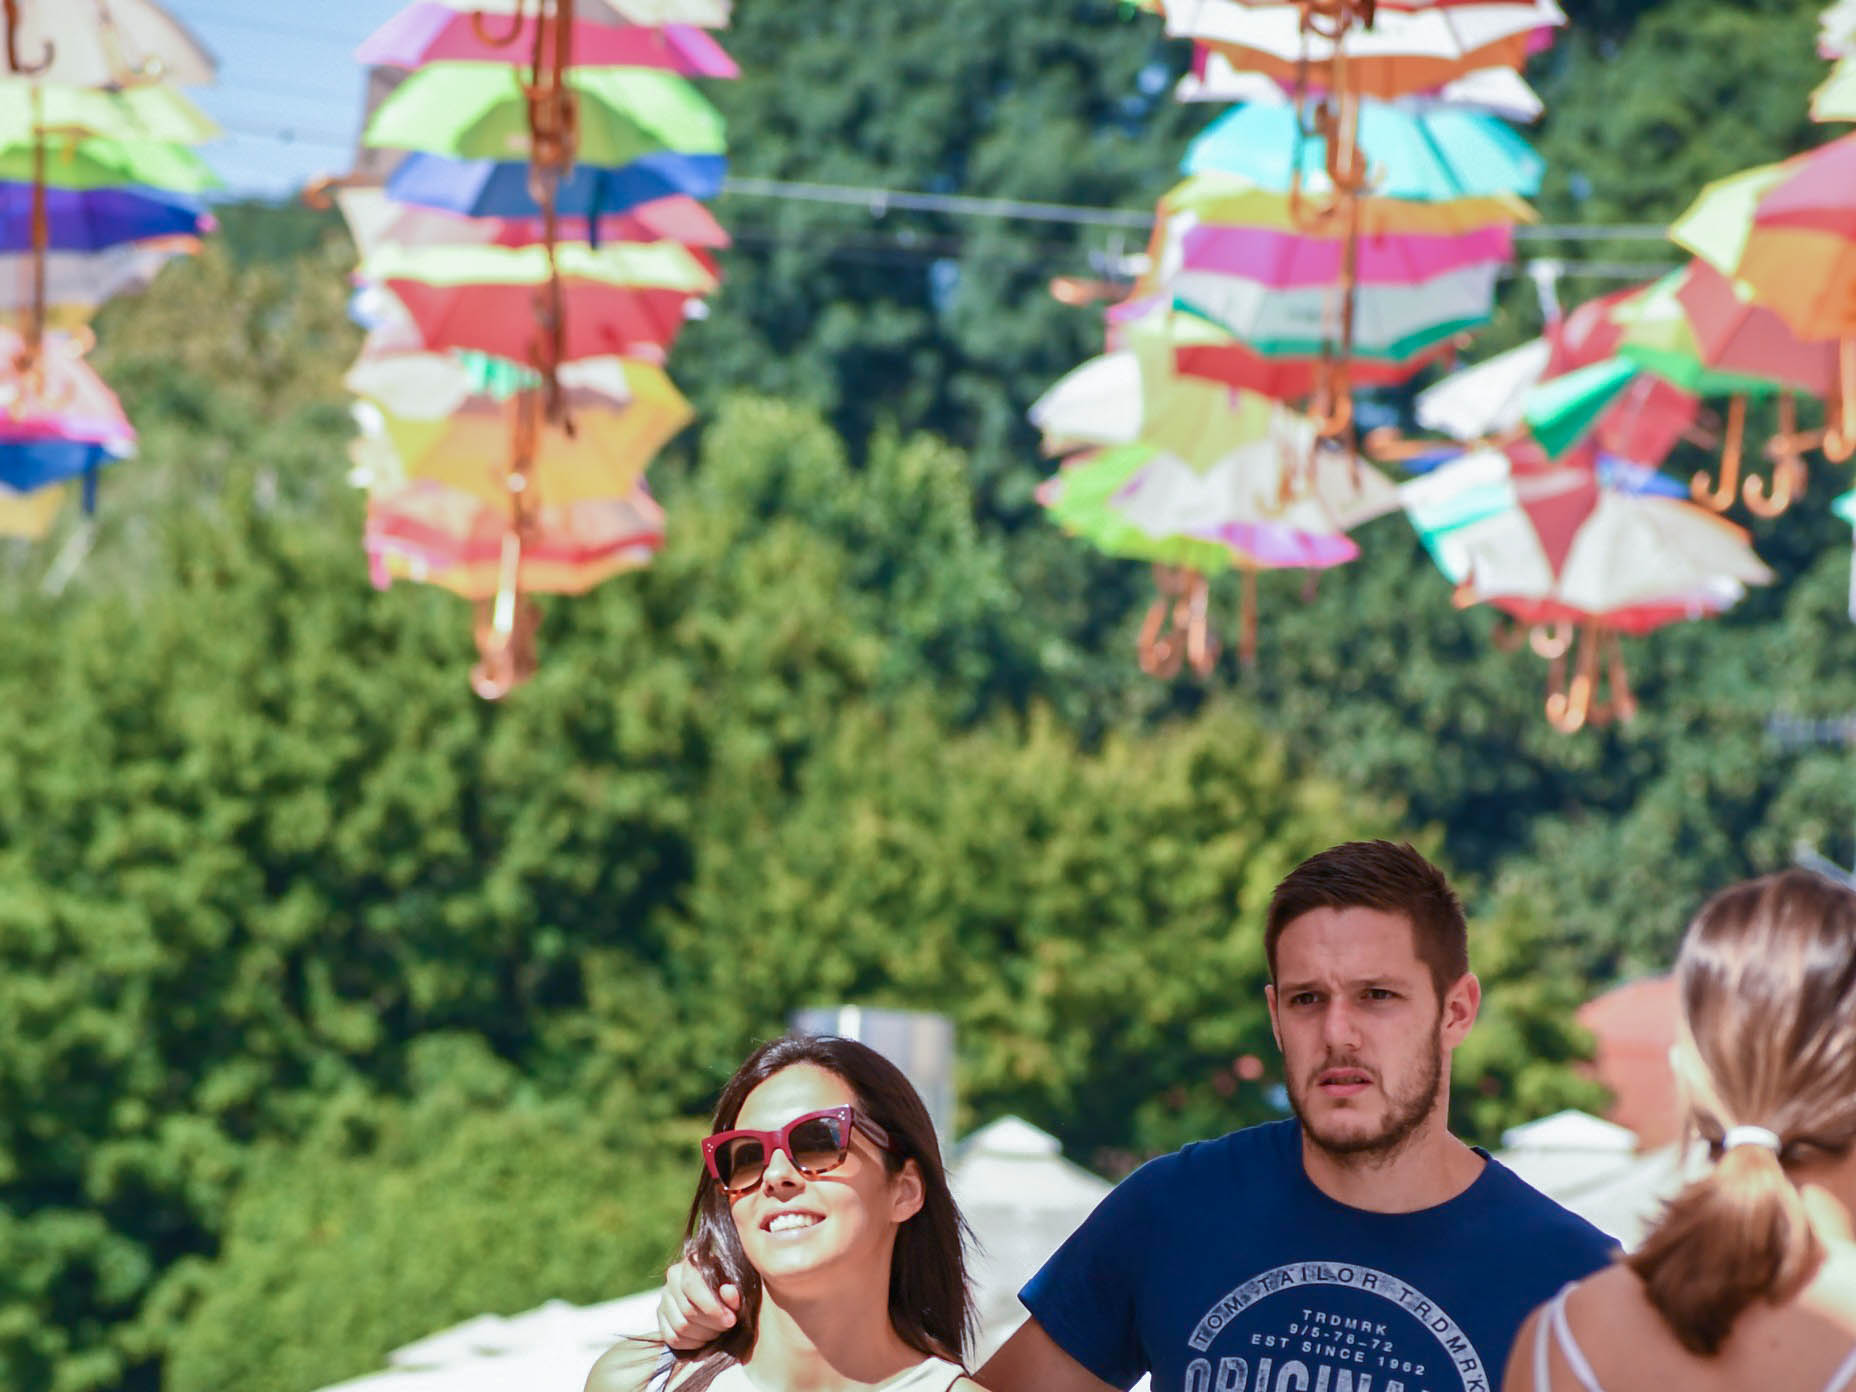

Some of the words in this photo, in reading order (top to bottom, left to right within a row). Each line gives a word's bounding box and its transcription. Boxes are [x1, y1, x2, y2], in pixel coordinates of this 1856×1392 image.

[1194, 1296, 1244, 1345] TOM
[1257, 1266, 1379, 1293] TAILOR
[1302, 1309, 1388, 1336] TRDMRK
[1251, 1334, 1290, 1348] EST
[1302, 1341, 1366, 1362] SINCE
[1378, 1356, 1425, 1376] 1962
